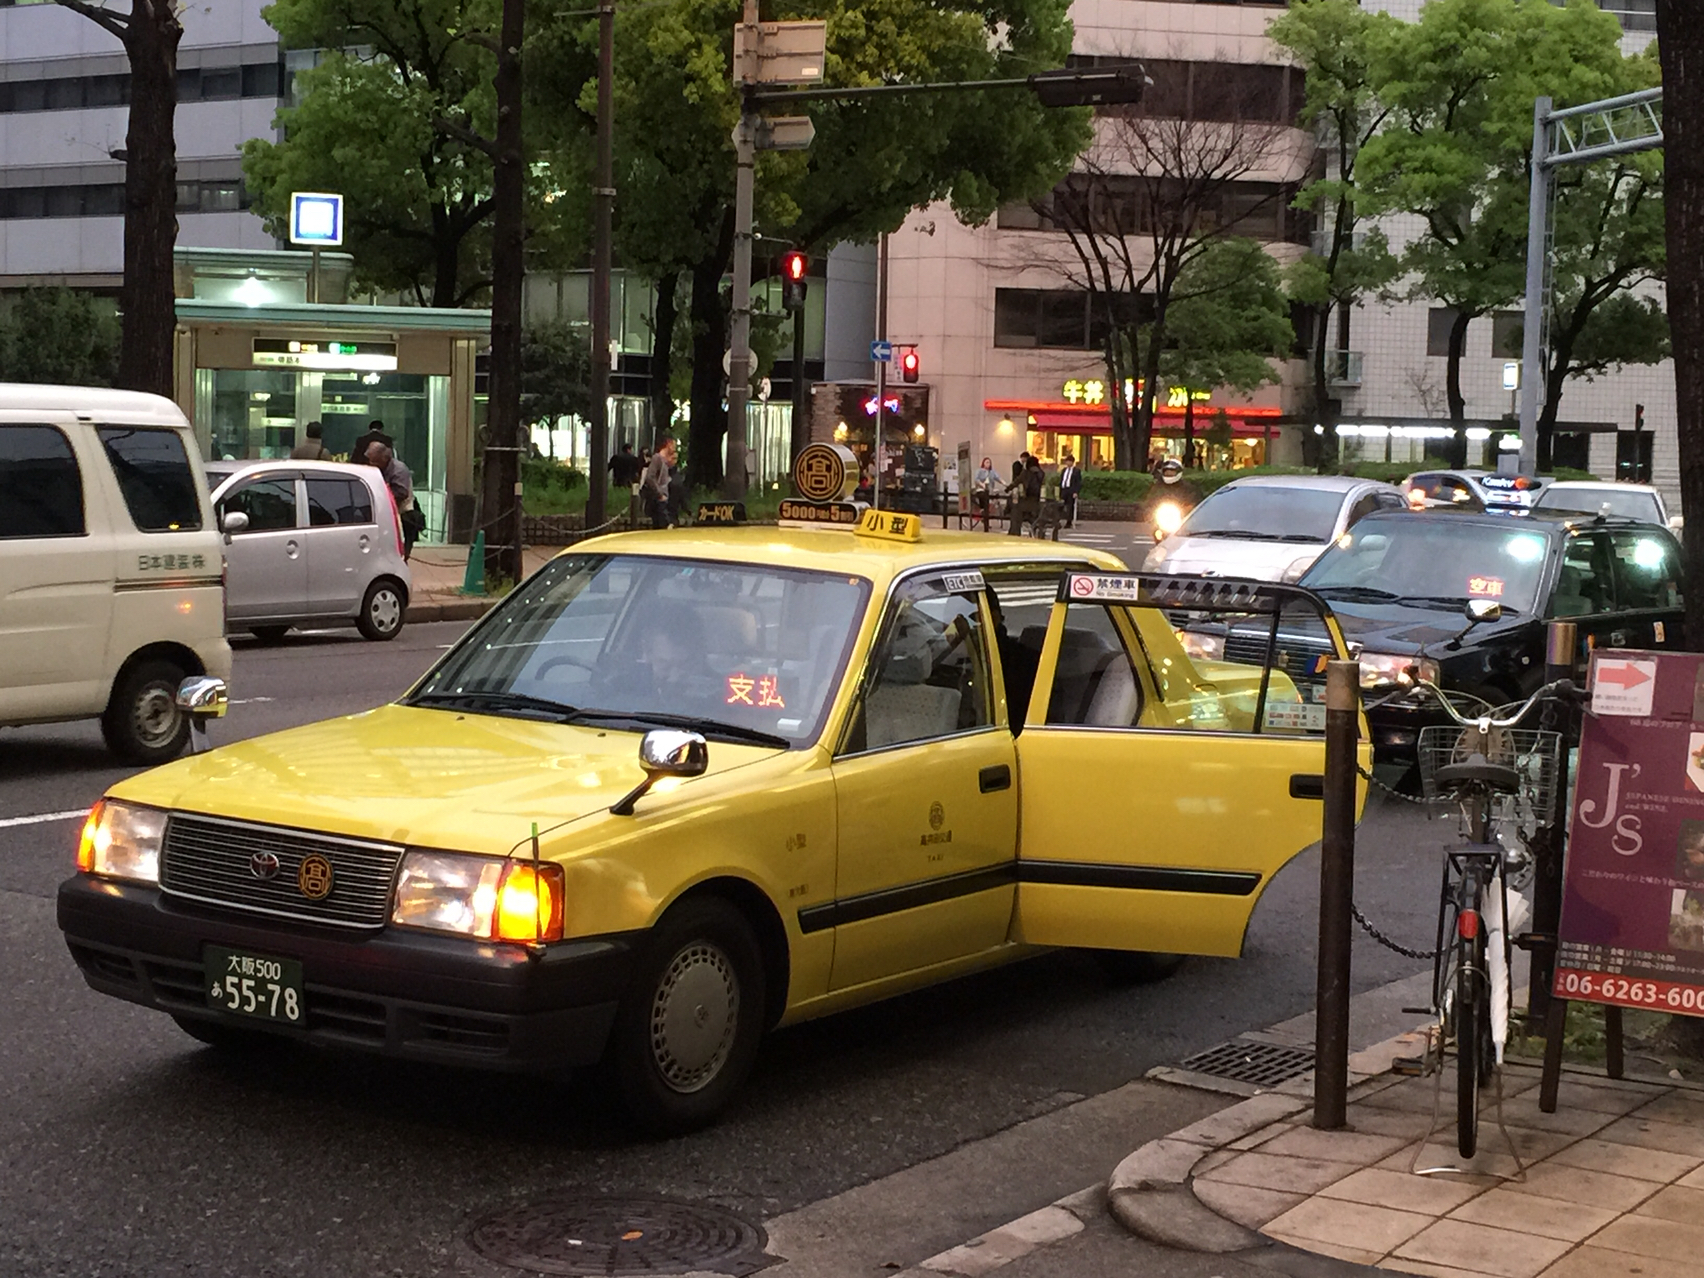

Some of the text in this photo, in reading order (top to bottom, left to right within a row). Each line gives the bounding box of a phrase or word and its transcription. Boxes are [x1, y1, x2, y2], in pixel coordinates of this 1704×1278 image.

[1063, 380, 1104, 405] 牛丼
[699, 505, 735, 521] カードOK
[866, 513, 909, 535] 小型
[946, 577, 965, 589] ETC
[1097, 578, 1136, 589] 禁煙車
[1469, 577, 1504, 596] 空車
[727, 674, 785, 708] 支払
[211, 975, 300, 1021] あ 55-78
